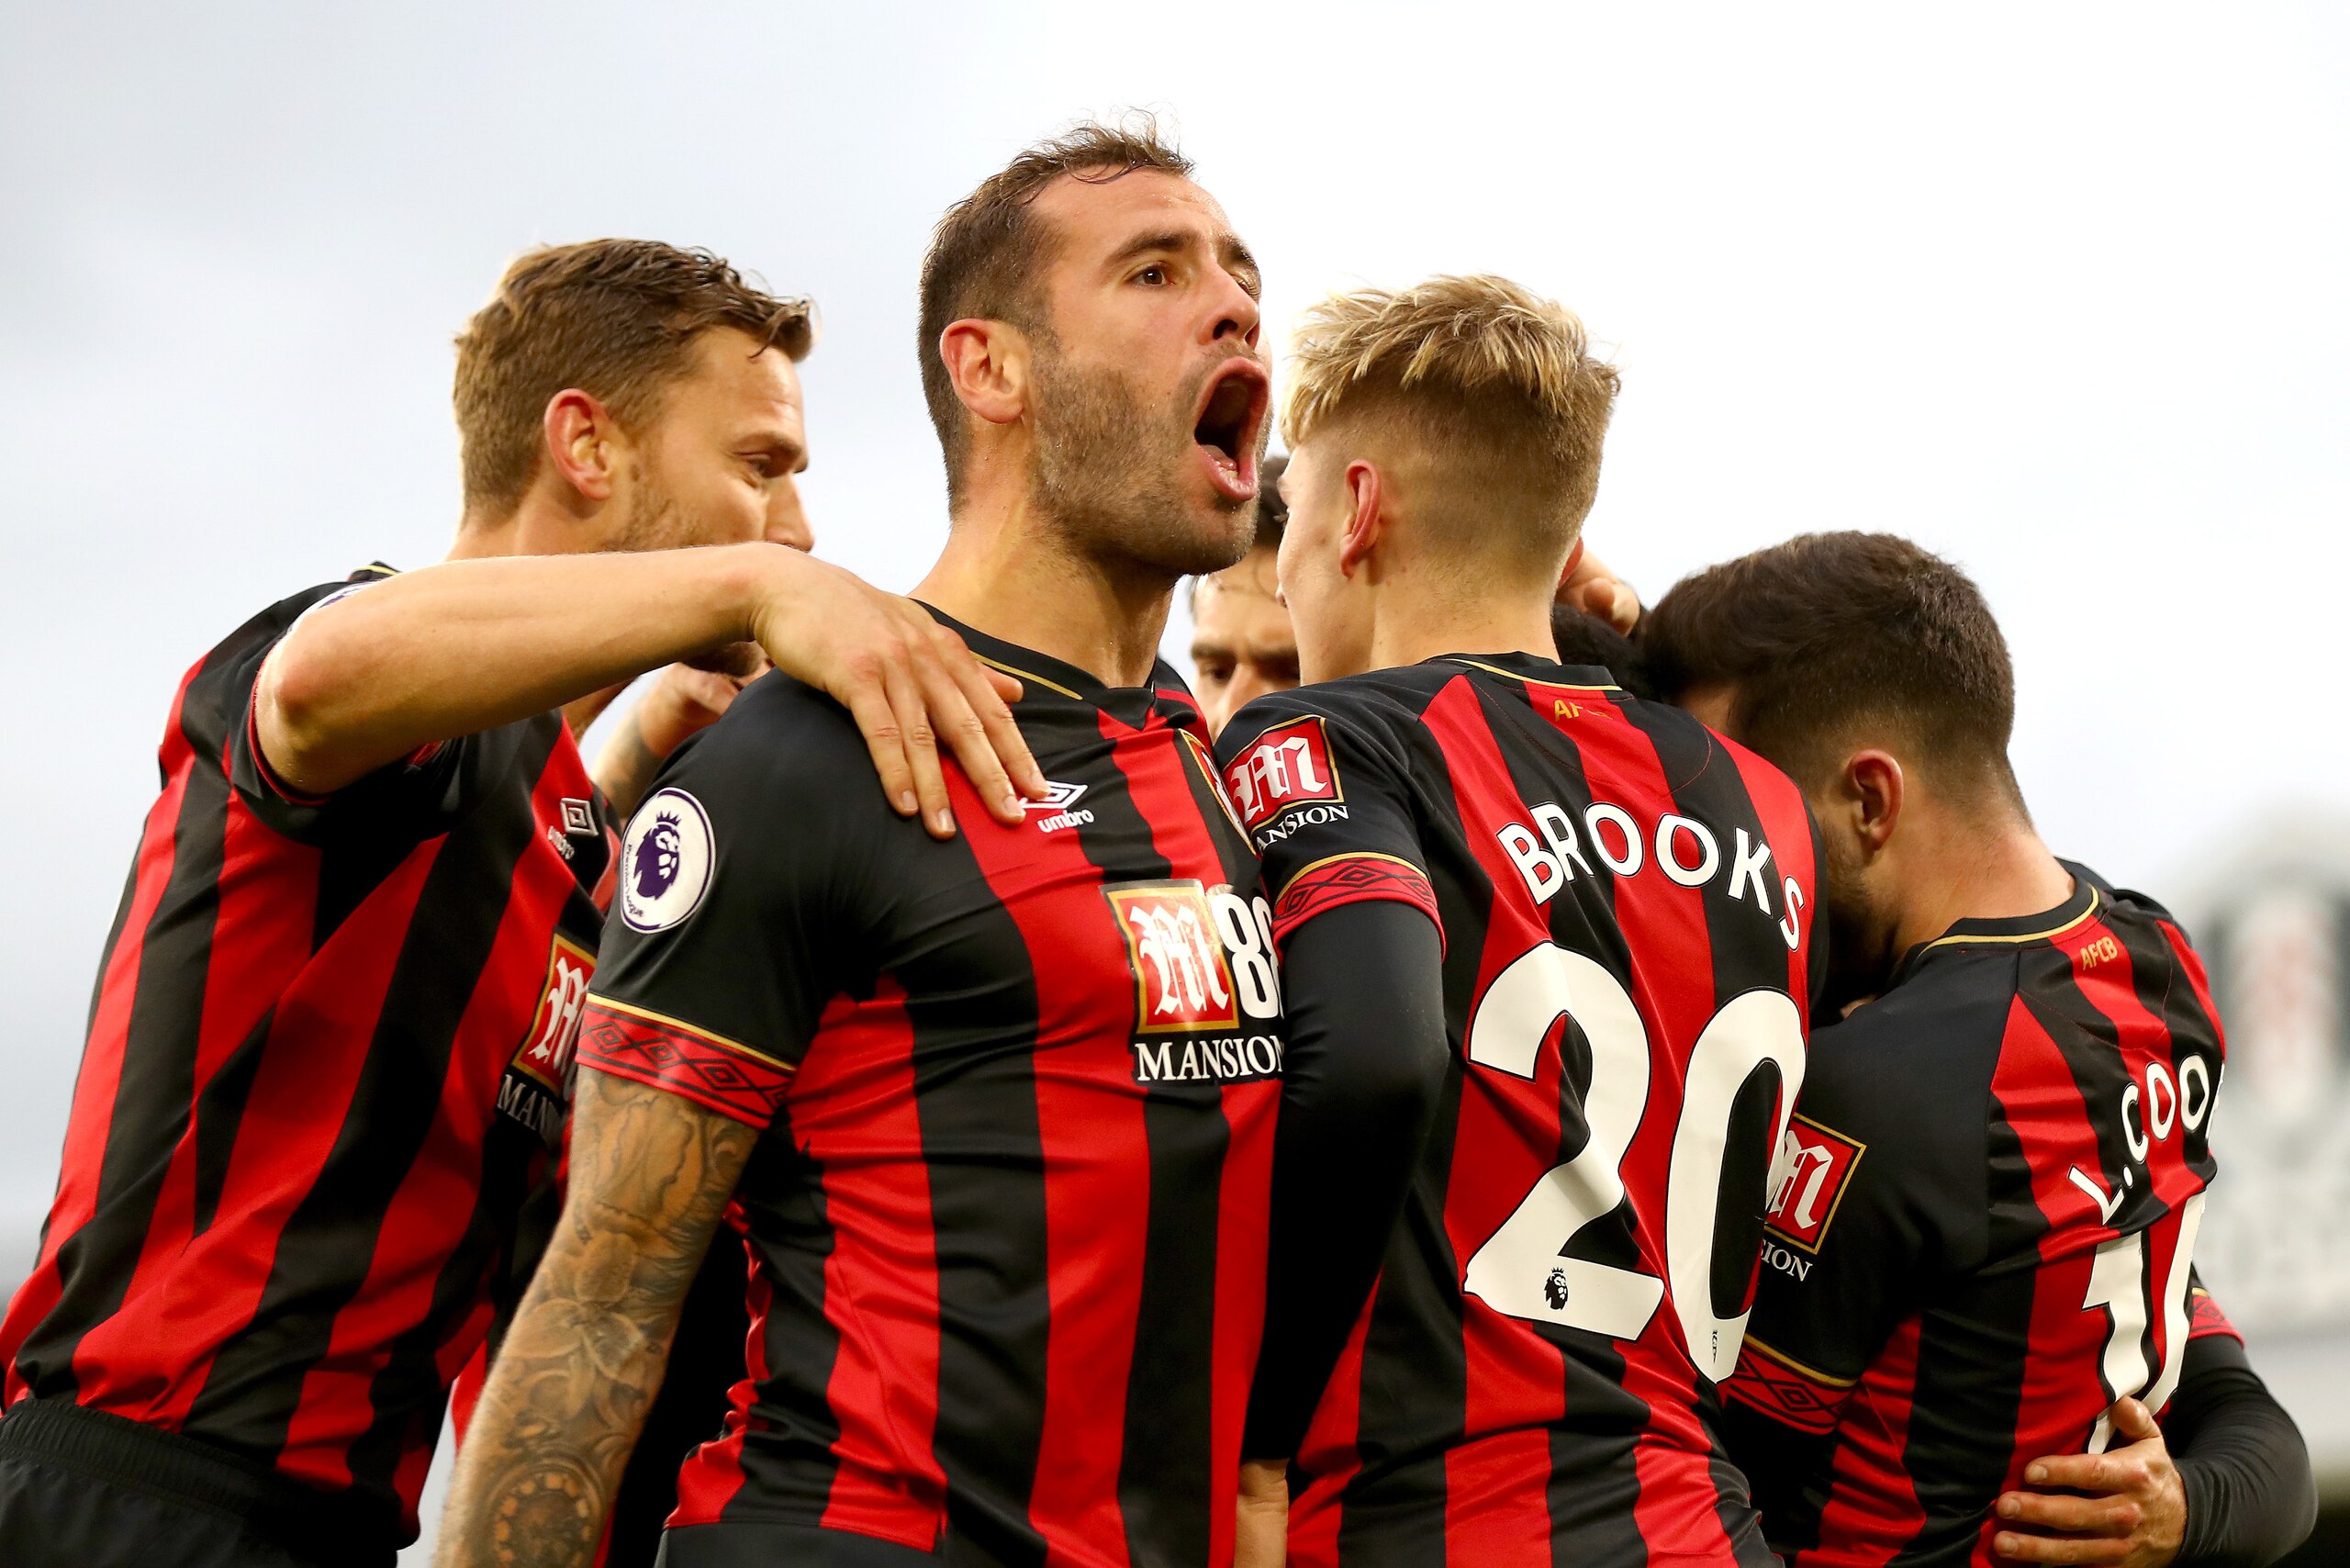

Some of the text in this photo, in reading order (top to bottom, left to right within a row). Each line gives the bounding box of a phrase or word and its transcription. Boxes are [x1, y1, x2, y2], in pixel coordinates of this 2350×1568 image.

[1037, 809, 1095, 833] umbro
[1256, 805, 1349, 856] ANSION
[1496, 801, 1805, 951] BROOKS
[2081, 935, 2118, 970] AFCB
[1135, 1036, 1284, 1081] MANSION
[1462, 940, 1807, 1383] 20
[2068, 1052, 2226, 1226] L.COO
